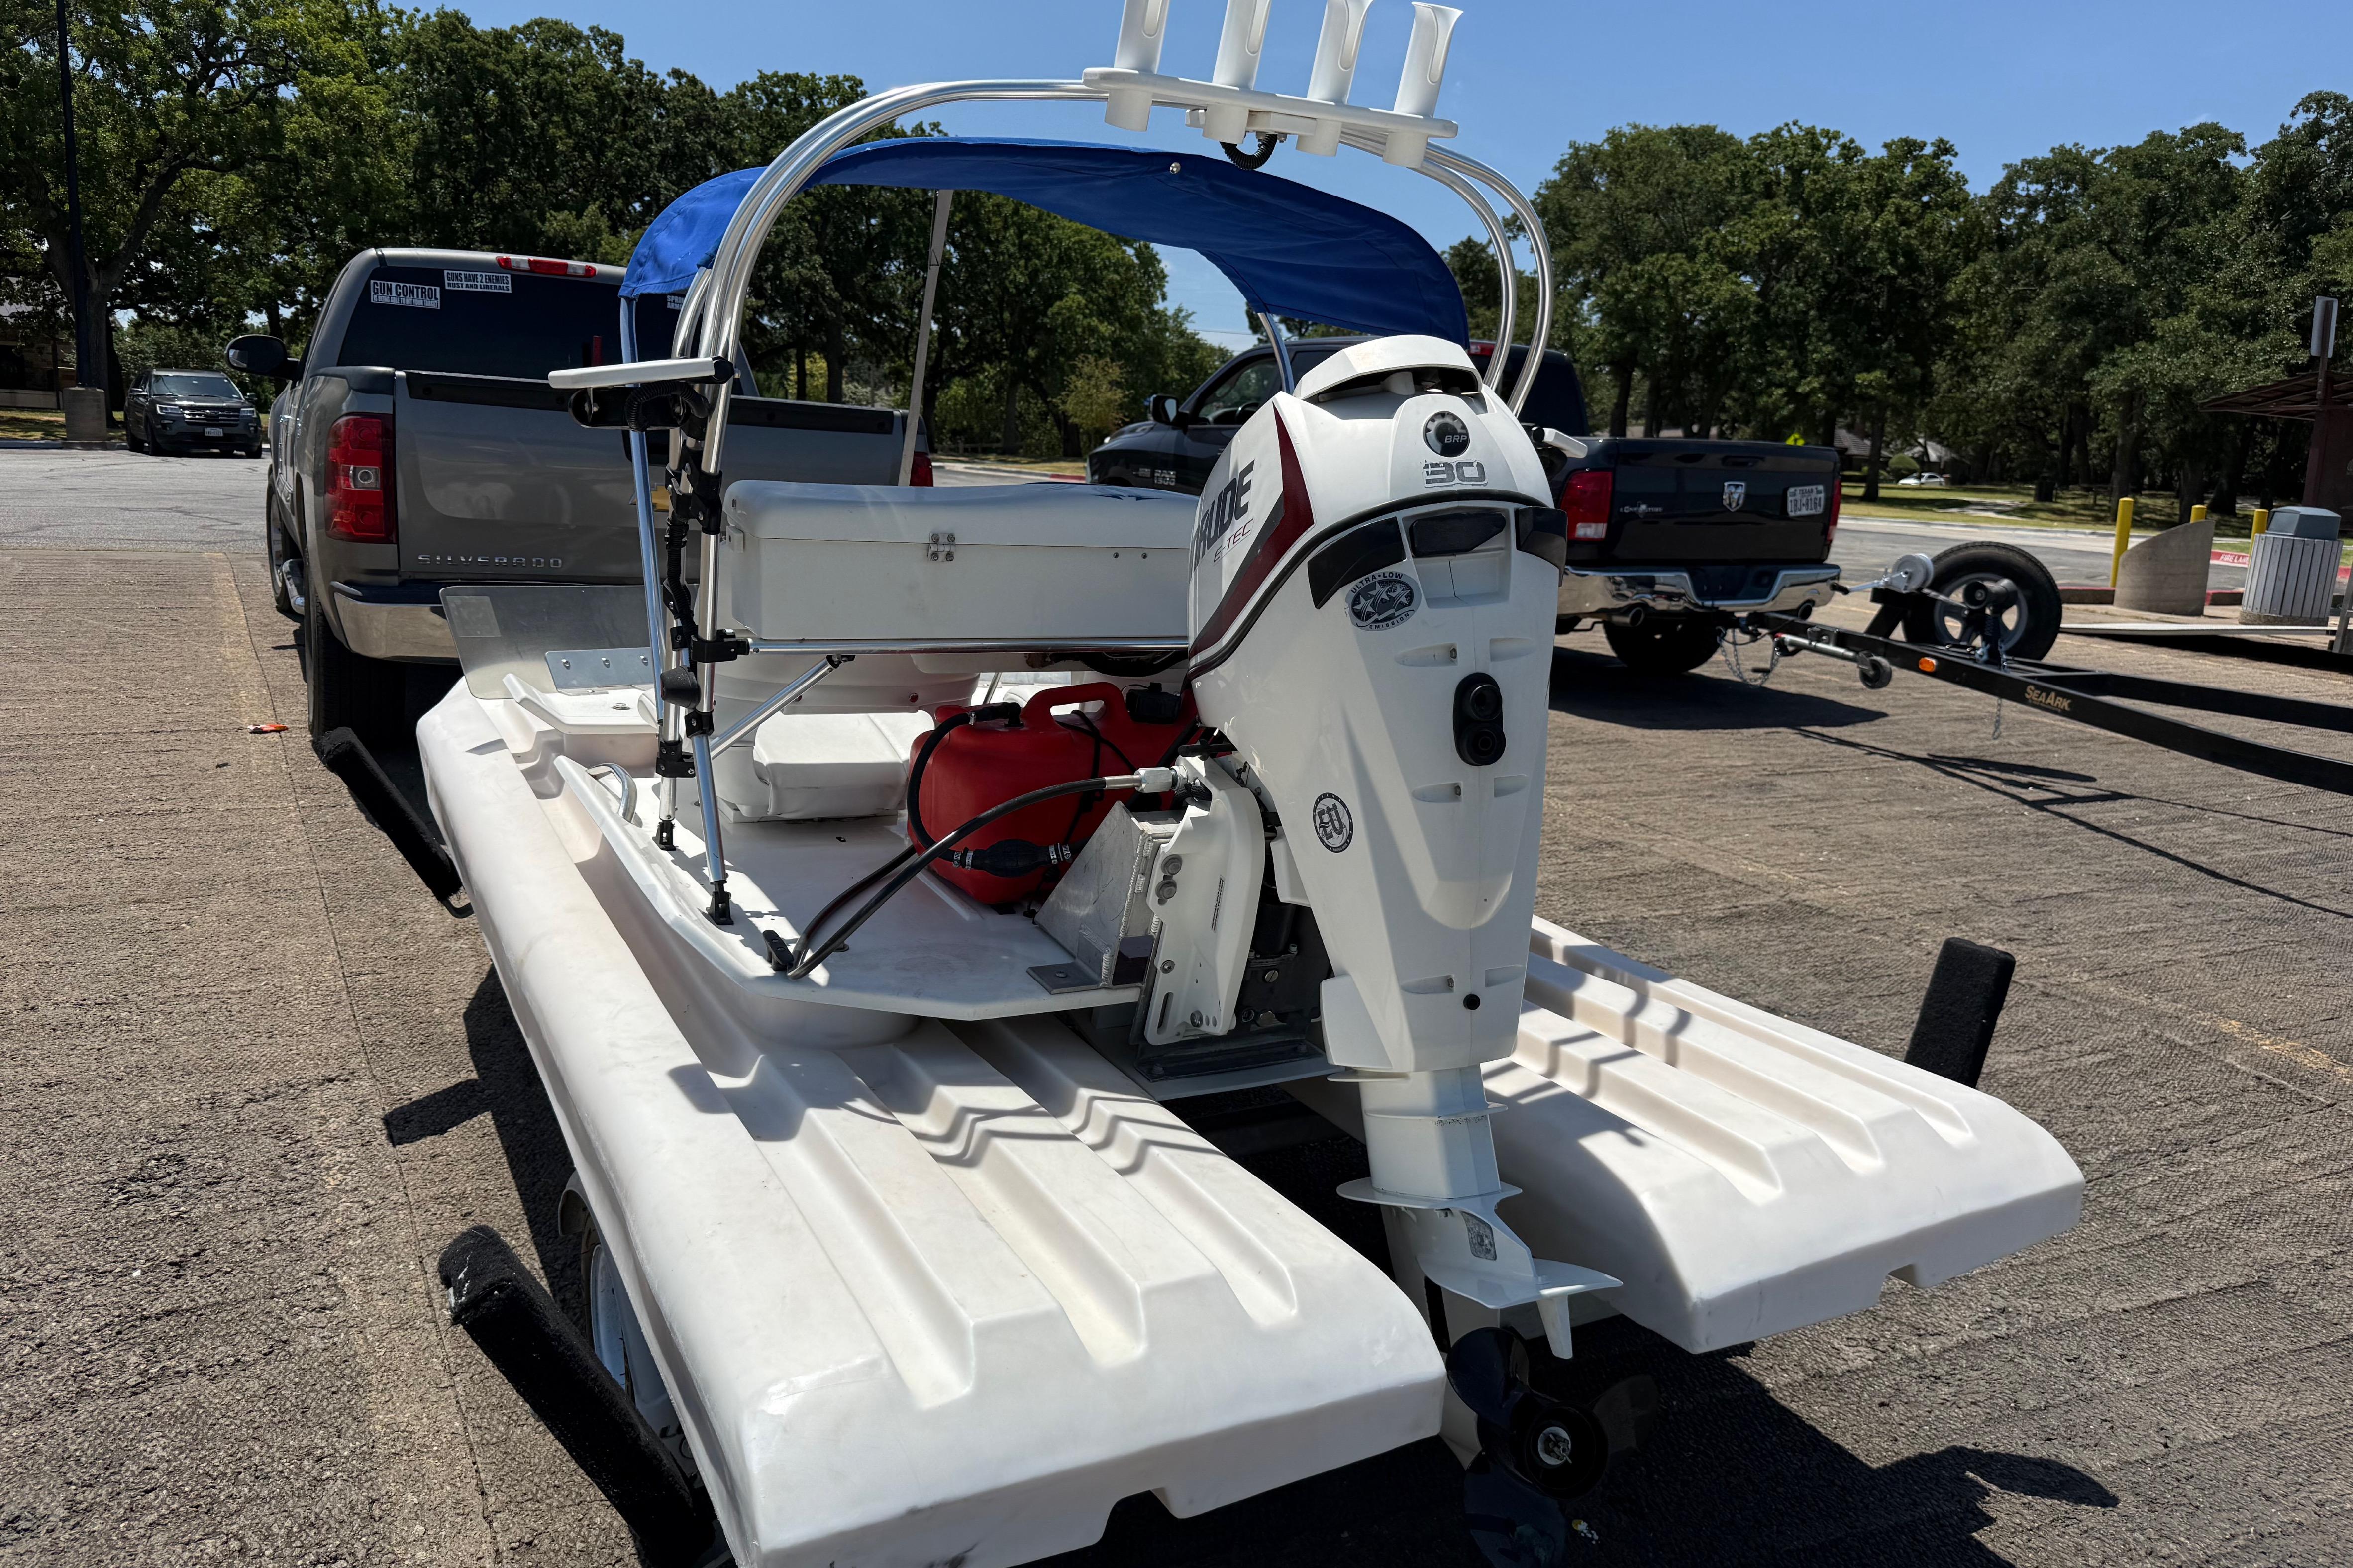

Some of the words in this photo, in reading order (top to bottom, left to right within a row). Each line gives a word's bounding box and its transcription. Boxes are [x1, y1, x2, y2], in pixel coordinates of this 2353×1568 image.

[447, 272, 463, 282] GUNS
[464, 273, 479, 283] HAVE
[480, 274, 484, 283] 2
[485, 274, 509, 285] ENEMIES
[373, 281, 393, 295] GUN
[395, 284, 438, 300] CONTROL
[1444, 435, 1467, 443] BRP
[1214, 518, 1253, 562] E-TEC
[418, 554, 562, 568] SILVERADO
[2219, 554, 2235, 562] FIRE
[1351, 574, 1377, 594] ULTRA
[1369, 612, 1410, 630] EMISSION
